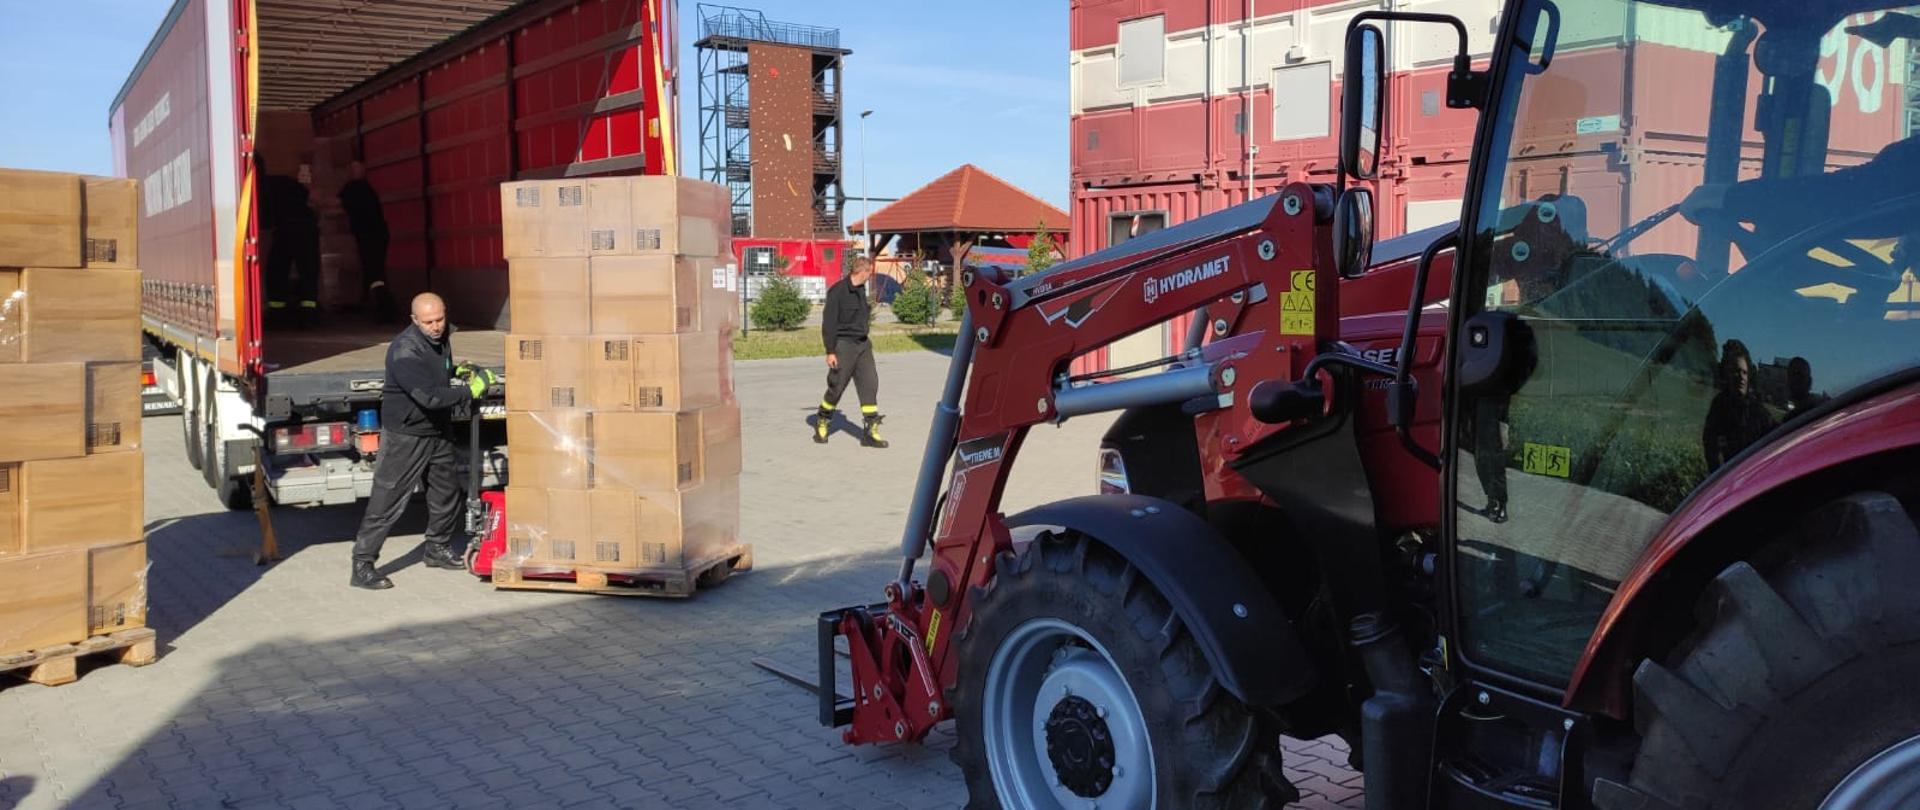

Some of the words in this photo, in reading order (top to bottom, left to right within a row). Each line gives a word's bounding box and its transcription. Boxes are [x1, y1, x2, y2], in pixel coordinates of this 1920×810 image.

[1159, 255, 1230, 294] HYDRAMET
[1291, 271, 1316, 292] CE
[144, 401, 178, 411] RENAUL
